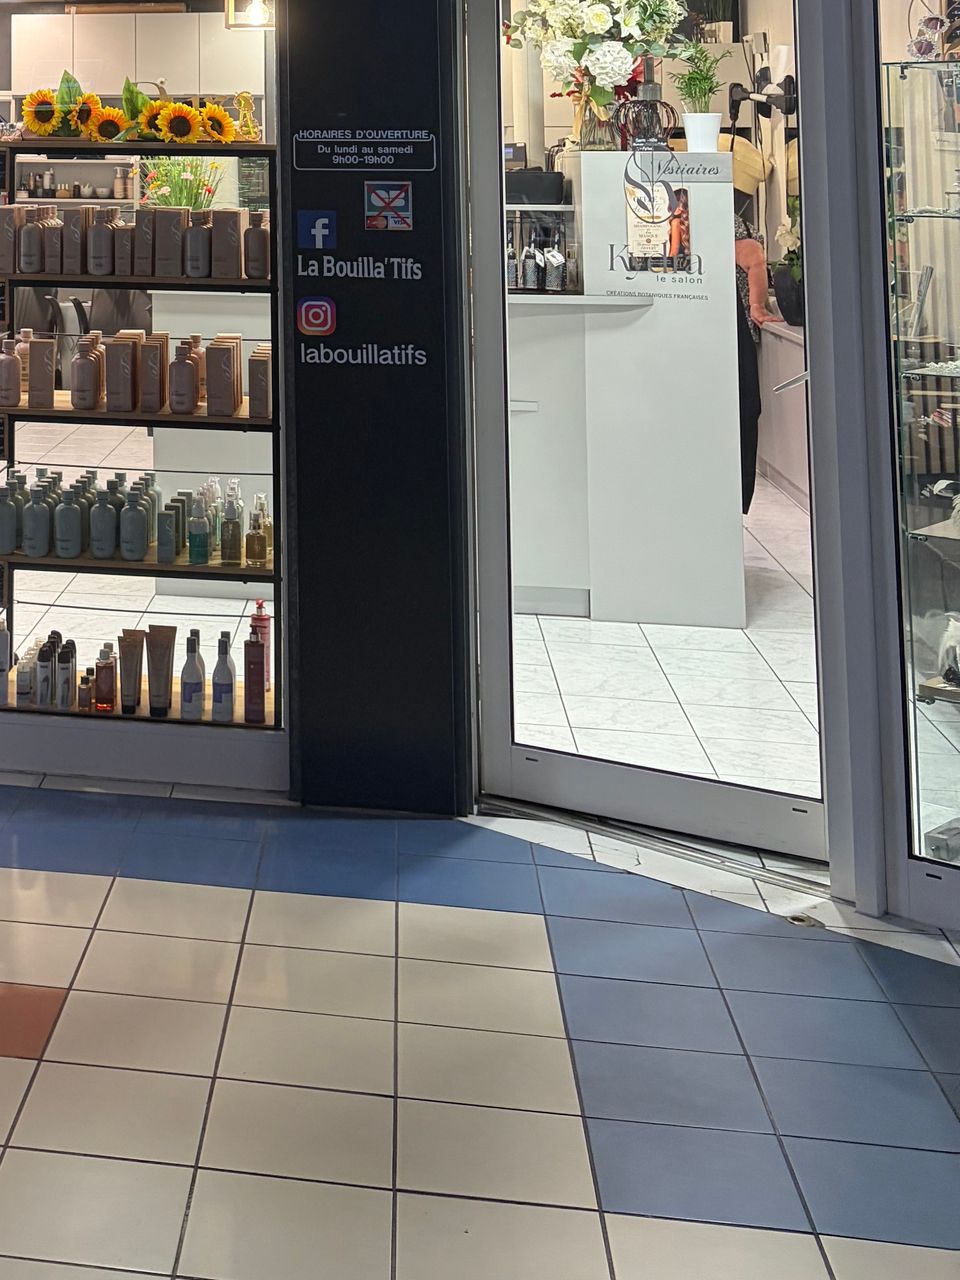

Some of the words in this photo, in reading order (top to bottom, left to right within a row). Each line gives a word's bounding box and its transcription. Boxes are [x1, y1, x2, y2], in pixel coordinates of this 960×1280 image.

[299, 129, 352, 139] HORAIRES
[355, 129, 429, 139] D'OUVERTURE
[317, 144, 331, 154] Du
[334, 144, 358, 154] lundi
[361, 146, 374, 154] au
[377, 144, 414, 154] samedi
[332, 155, 395, 165] 9h00-19h00
[654, 159, 720, 175] Vestiaires
[297, 254, 319, 277] La
[608, 239, 706, 280] Kydra
[656, 274, 666, 282] le
[671, 275, 703, 284] salon
[300, 342, 428, 366] labouillatifs
